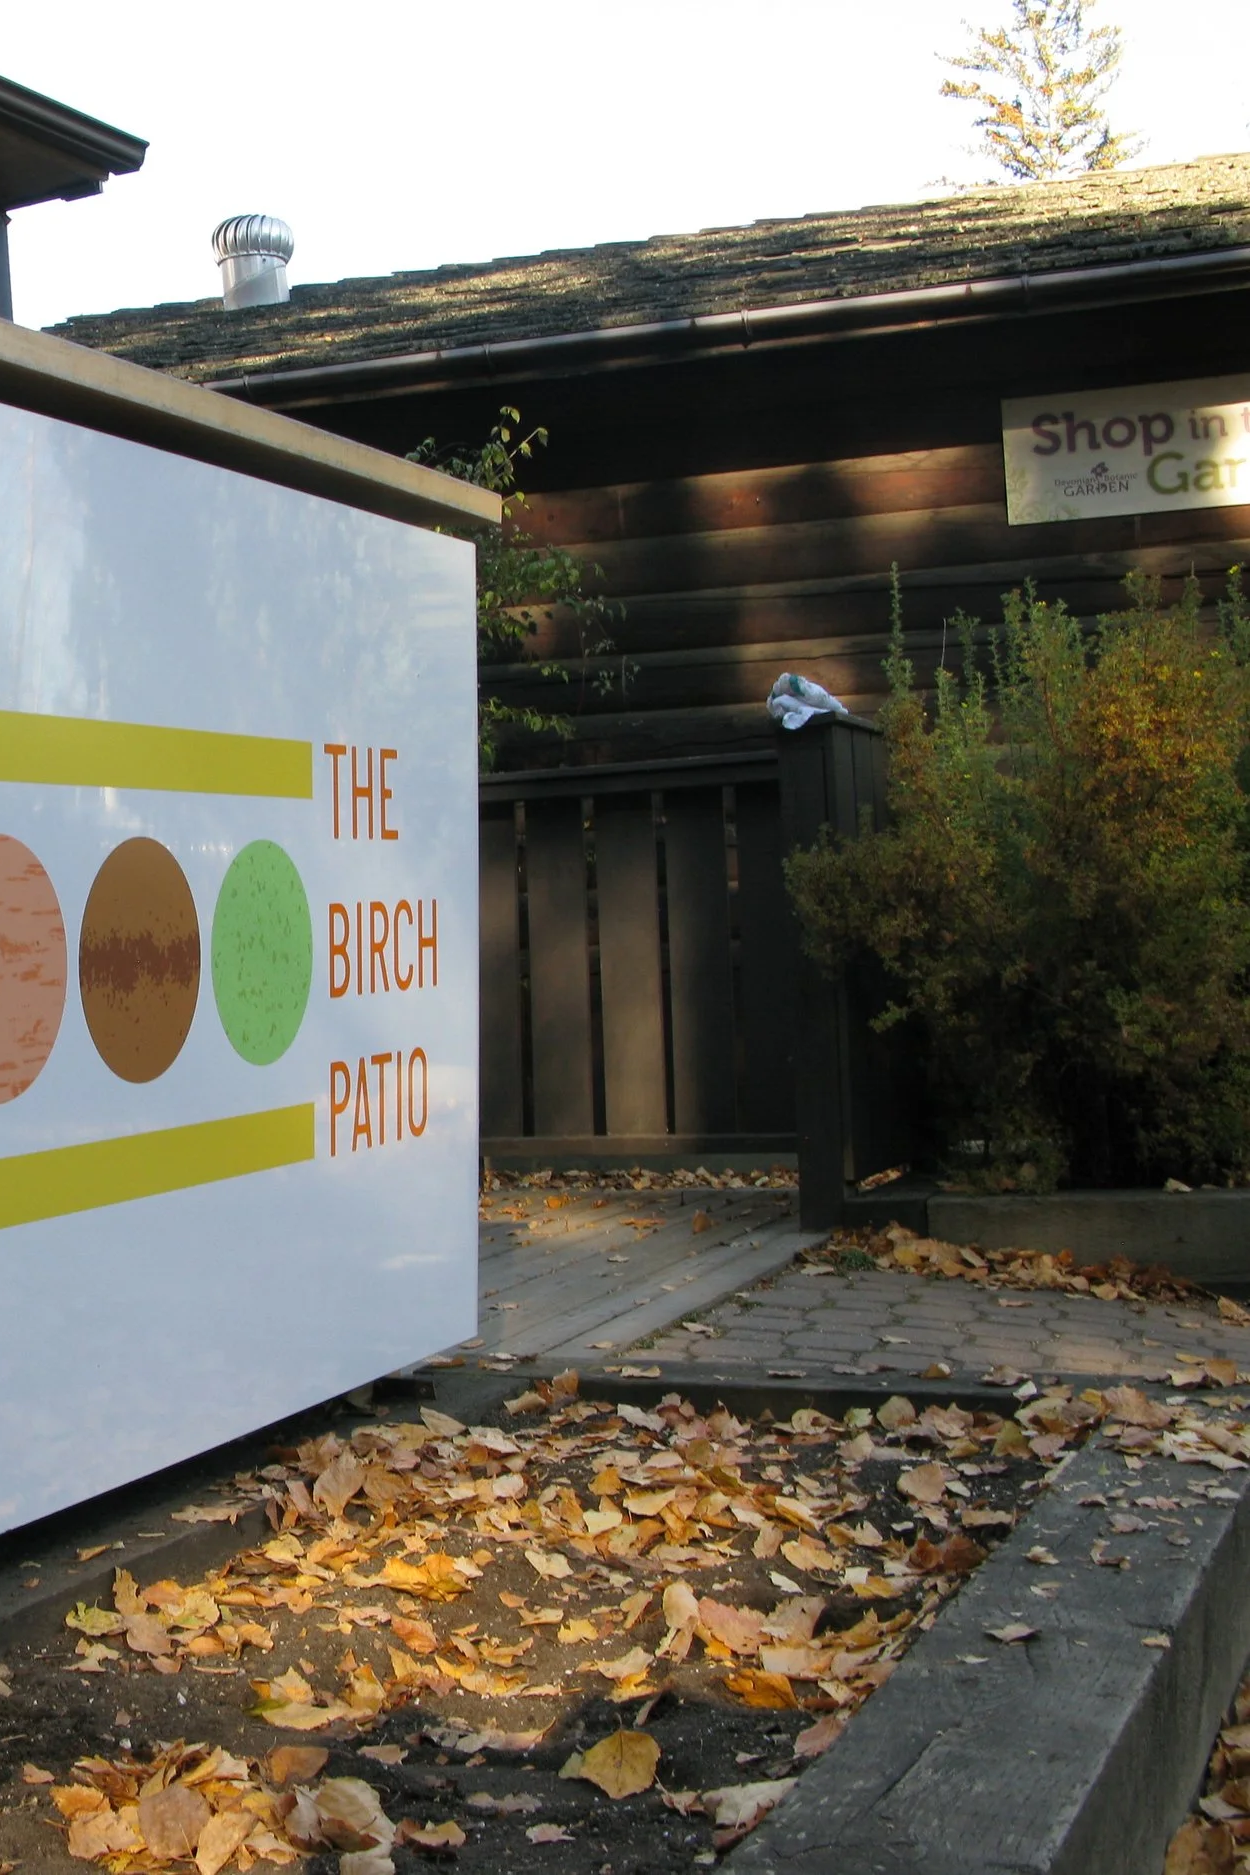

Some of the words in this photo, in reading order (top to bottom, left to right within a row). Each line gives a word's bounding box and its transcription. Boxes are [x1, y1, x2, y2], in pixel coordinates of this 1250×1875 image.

[1031, 410, 1175, 457] Shop
[1188, 409, 1228, 440] in
[1063, 480, 1129, 497] GARDEN
[1147, 450, 1247, 495] Gar
[323, 743, 399, 840] THE
[328, 898, 438, 999] BIRCH
[329, 1046, 429, 1157] PATIO
